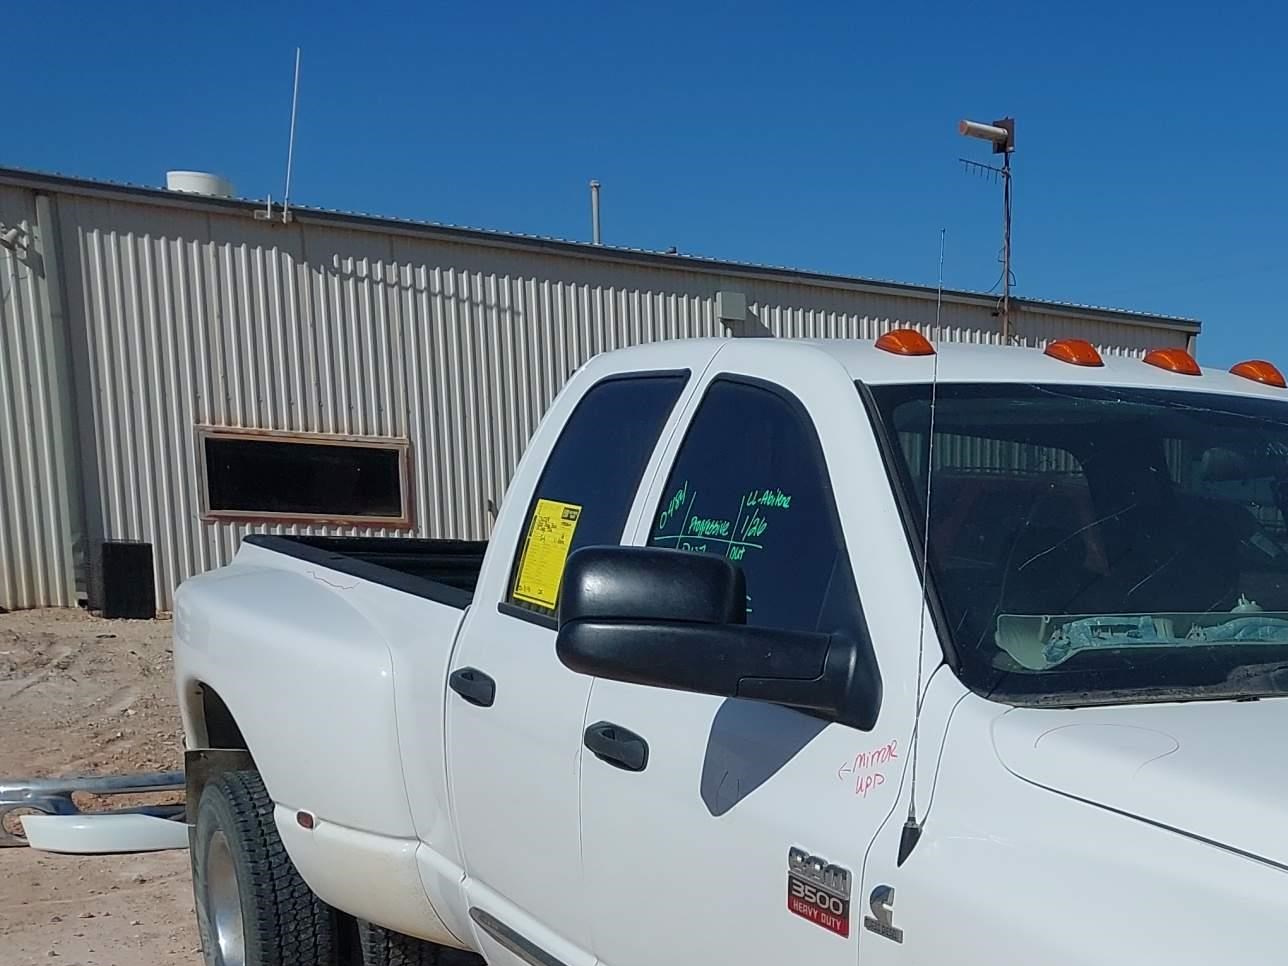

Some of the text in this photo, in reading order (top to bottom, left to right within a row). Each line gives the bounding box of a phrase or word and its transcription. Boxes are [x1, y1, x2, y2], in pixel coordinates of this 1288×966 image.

[791, 879, 843, 916] 3500
[793, 898, 818, 921] HEAVY
[821, 913, 843, 931] DUTY
